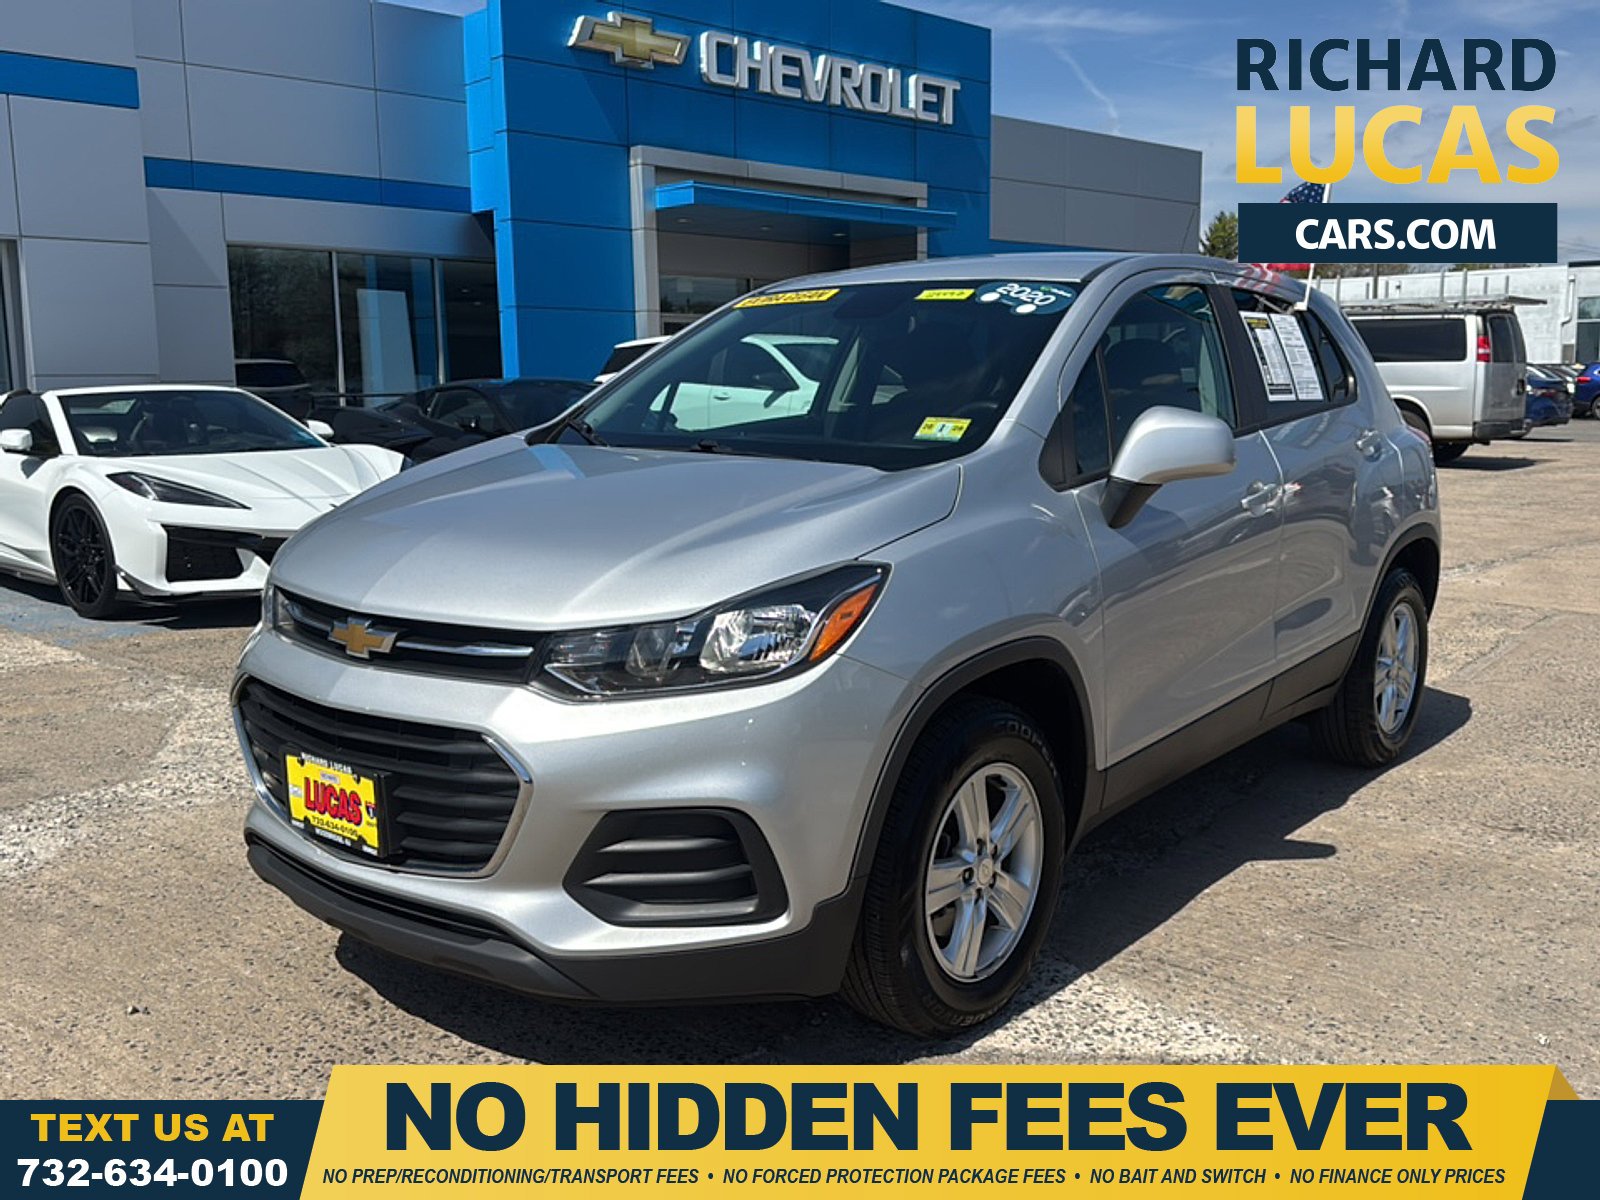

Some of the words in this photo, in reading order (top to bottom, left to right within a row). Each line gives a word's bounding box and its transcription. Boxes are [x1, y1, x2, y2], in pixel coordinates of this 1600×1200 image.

[700, 30, 961, 125] CHEVROLET
[996, 283, 1056, 306] 2020
[303, 776, 363, 826] LUCAS
